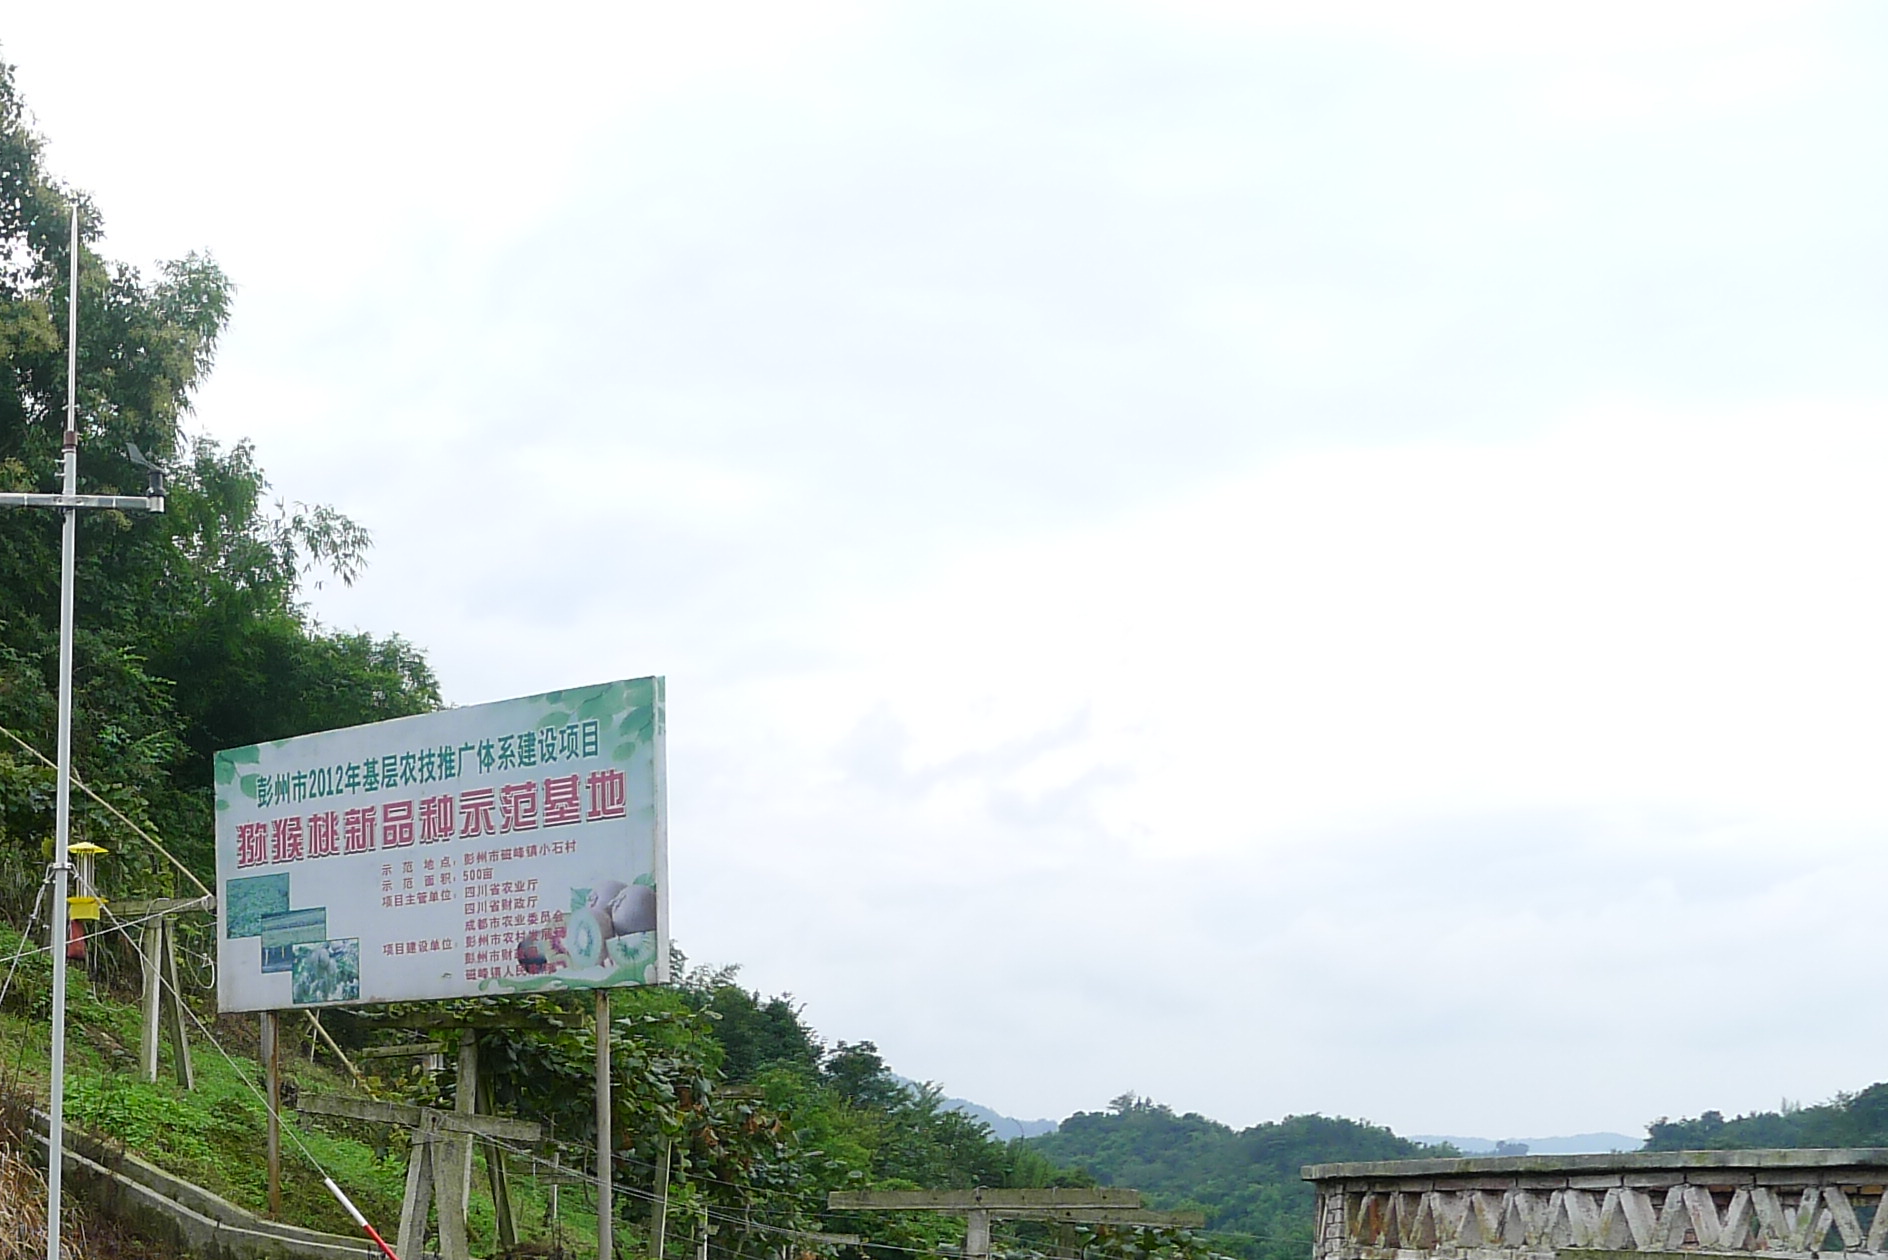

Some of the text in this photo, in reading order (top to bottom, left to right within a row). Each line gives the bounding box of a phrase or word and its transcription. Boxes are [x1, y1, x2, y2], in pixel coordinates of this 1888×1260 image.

[256, 719, 599, 809] 彭州市2012年基层农技推广体系建设项目
[235, 768, 628, 869] 猕猴桃新品种示范基地
[462, 867, 494, 882] 500亩
[464, 878, 539, 898] 四川省农业厅
[464, 895, 539, 915] 四川省财政厅
[464, 909, 565, 932] 成都市农业委员会
